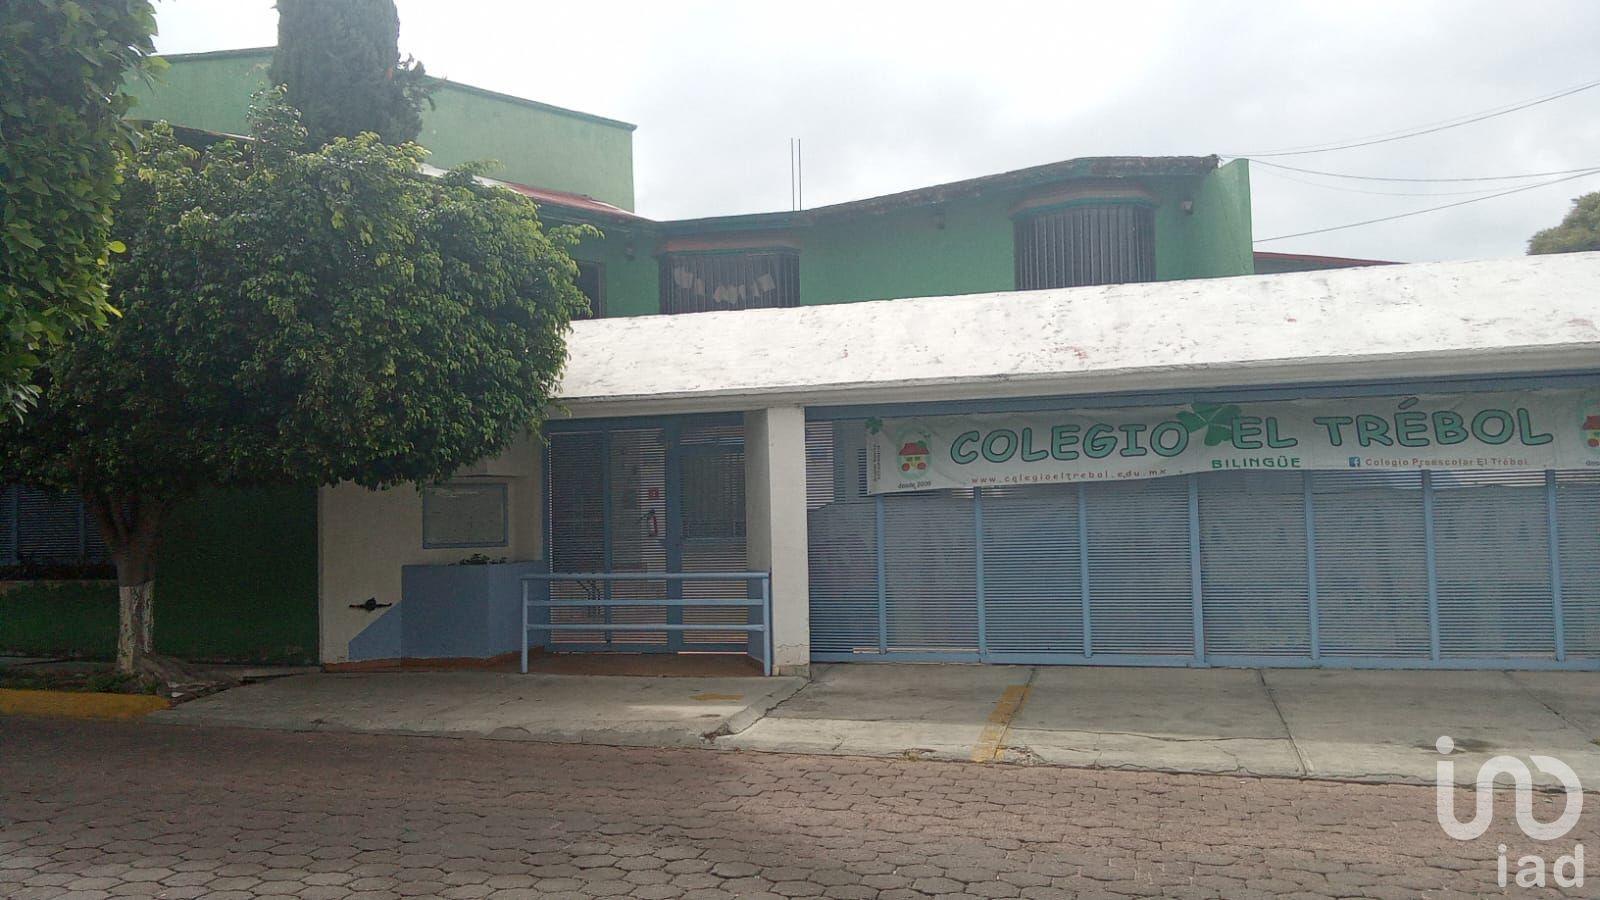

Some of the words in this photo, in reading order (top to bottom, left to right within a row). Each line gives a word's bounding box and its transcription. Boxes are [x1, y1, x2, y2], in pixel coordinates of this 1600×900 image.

[950, 420, 1189, 465] COLEGIO
[1232, 416, 1298, 450] EL
[1313, 397, 1554, 448] TRÉBOL
[1211, 455, 1302, 469] BILINGÜE
[1365, 457, 1409, 467] Colegio
[1477, 457, 1488, 467] El
